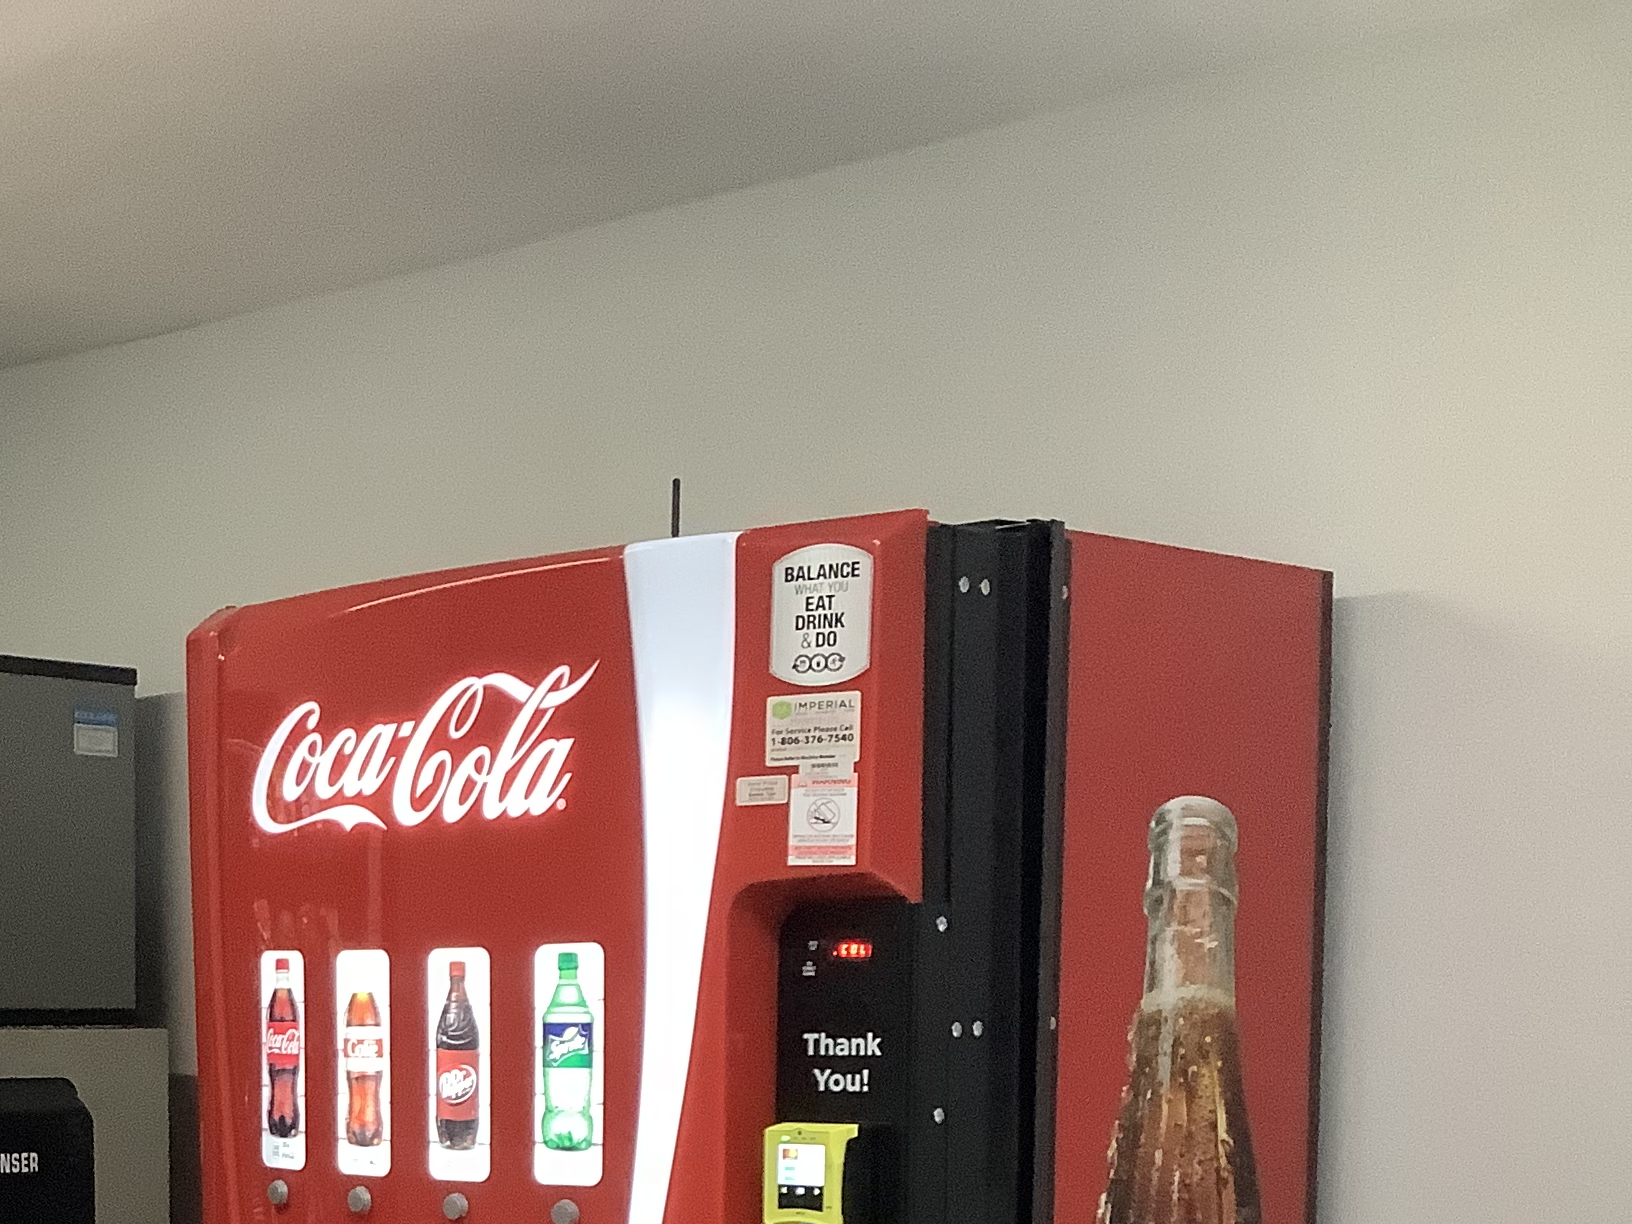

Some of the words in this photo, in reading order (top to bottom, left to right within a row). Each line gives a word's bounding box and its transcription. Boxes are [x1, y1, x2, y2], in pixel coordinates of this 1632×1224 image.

[784, 561, 860, 582] BALANCE
[794, 583, 823, 595] WHAT
[827, 581, 849, 593] YOU
[805, 594, 835, 612] EAT
[795, 612, 845, 631] DRINK
[801, 632, 811, 649] &
[815, 631, 837, 648] DO
[794, 699, 855, 713] IMPERIAL
[785, 727, 811, 735] Service
[839, 724, 854, 732] Call
[252, 659, 600, 834] Coca-Cola
[771, 733, 854, 746] 1-806-376-7540
[802, 1032, 882, 1056] Thank
[813, 1069, 869, 1092] You!
